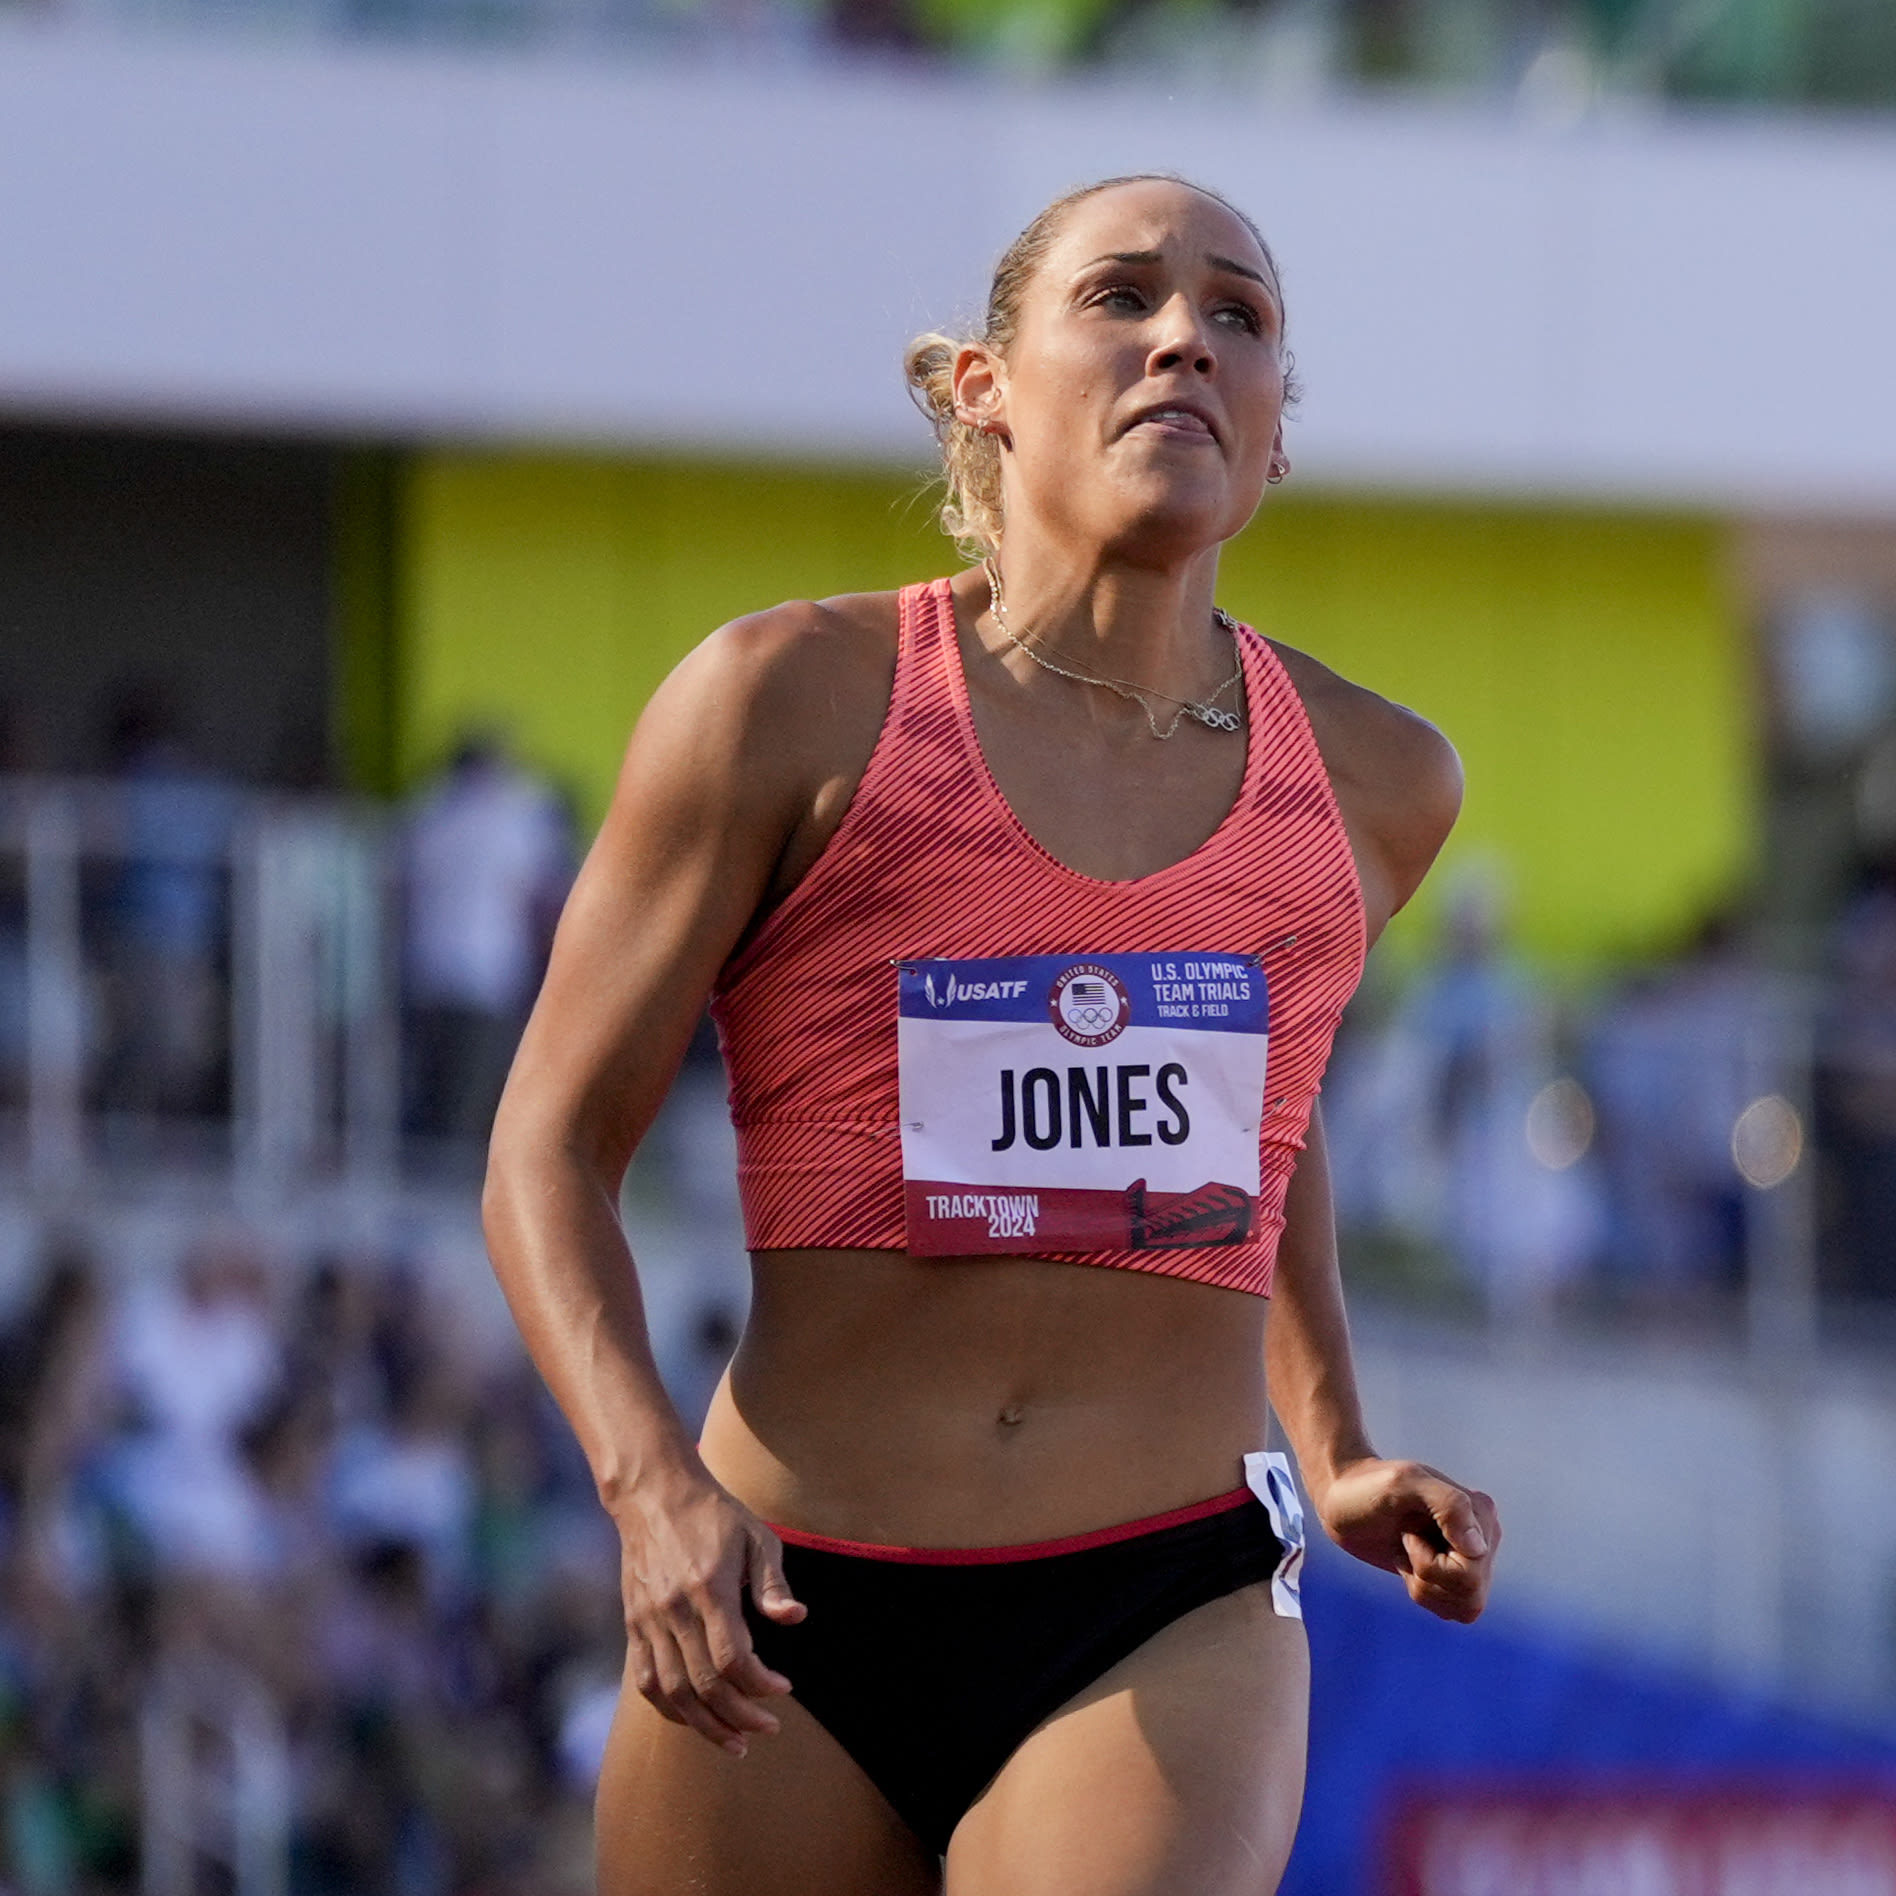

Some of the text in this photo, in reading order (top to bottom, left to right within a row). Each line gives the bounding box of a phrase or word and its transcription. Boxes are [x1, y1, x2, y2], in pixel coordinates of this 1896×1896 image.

[1057, 965, 1119, 988] UNITED STATES
[1151, 962, 1249, 981] U.S. OLYMPIC
[957, 981, 1028, 1001] USATF
[1153, 982, 1251, 1001] TEAM TRIALS
[1157, 1004, 1229, 1017] TRACK & FIELD
[1060, 1023, 1122, 1045] OLYMPIC TEAM
[991, 1062, 1190, 1152] JONES
[925, 1195, 1040, 1219] TRACKTOWN
[988, 1215, 1036, 1238] 2024
